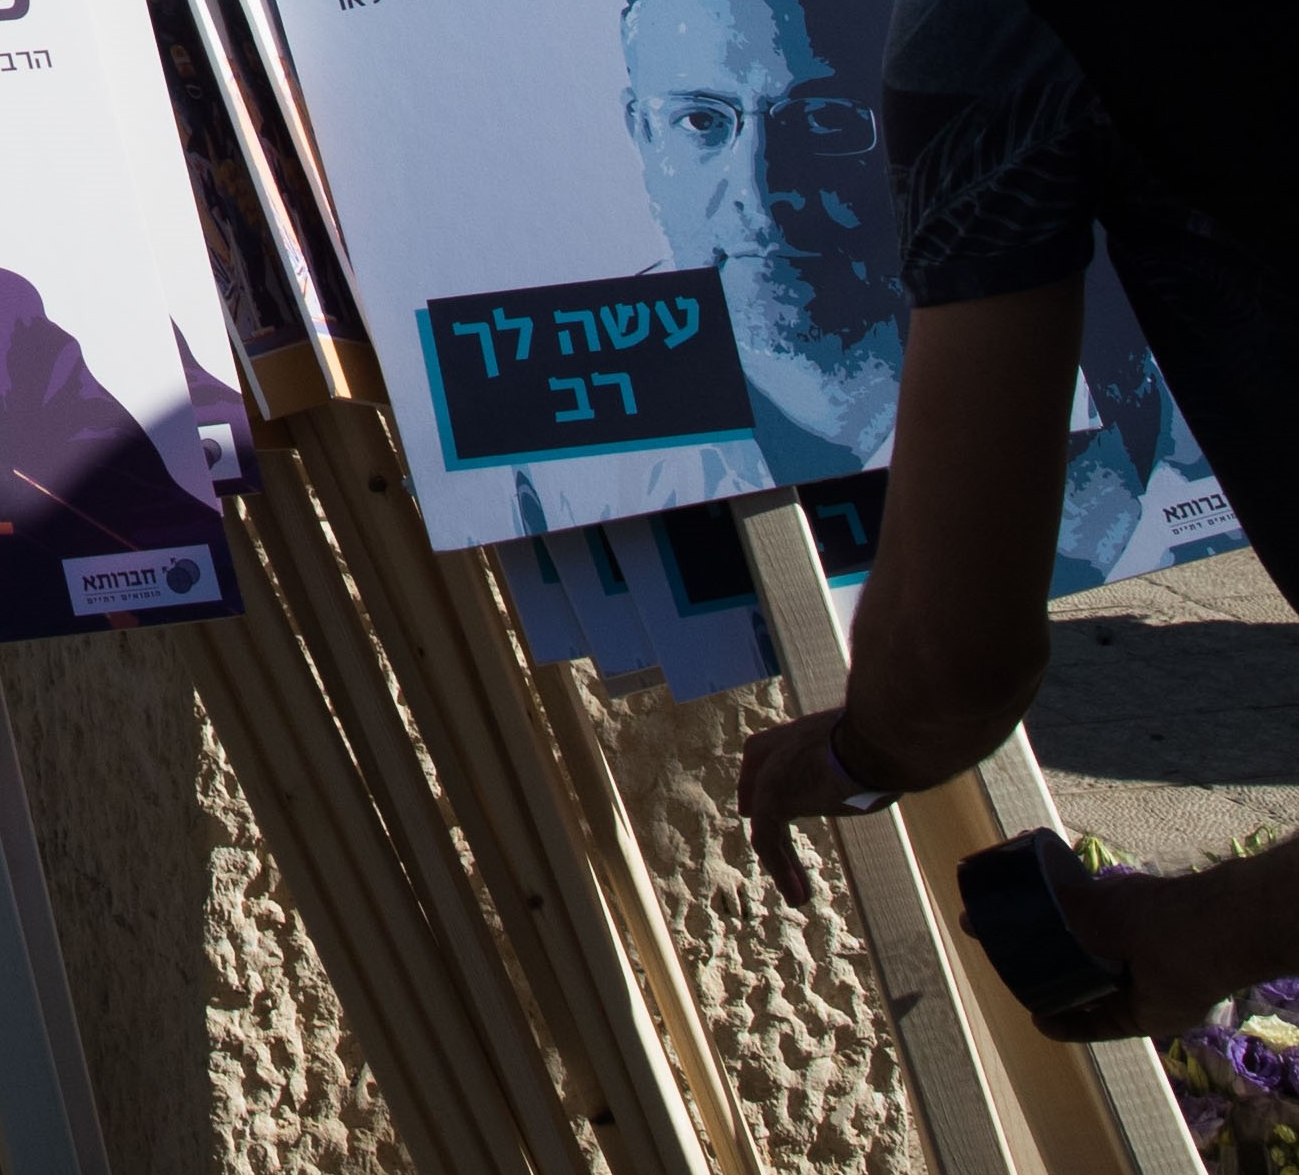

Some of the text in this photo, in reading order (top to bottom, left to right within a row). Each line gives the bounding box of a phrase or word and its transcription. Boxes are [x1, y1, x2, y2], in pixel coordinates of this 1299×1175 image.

[451, 296, 700, 378] עשה לך
[548, 371, 638, 425] רב
[82, 568, 157, 591] חברותא
